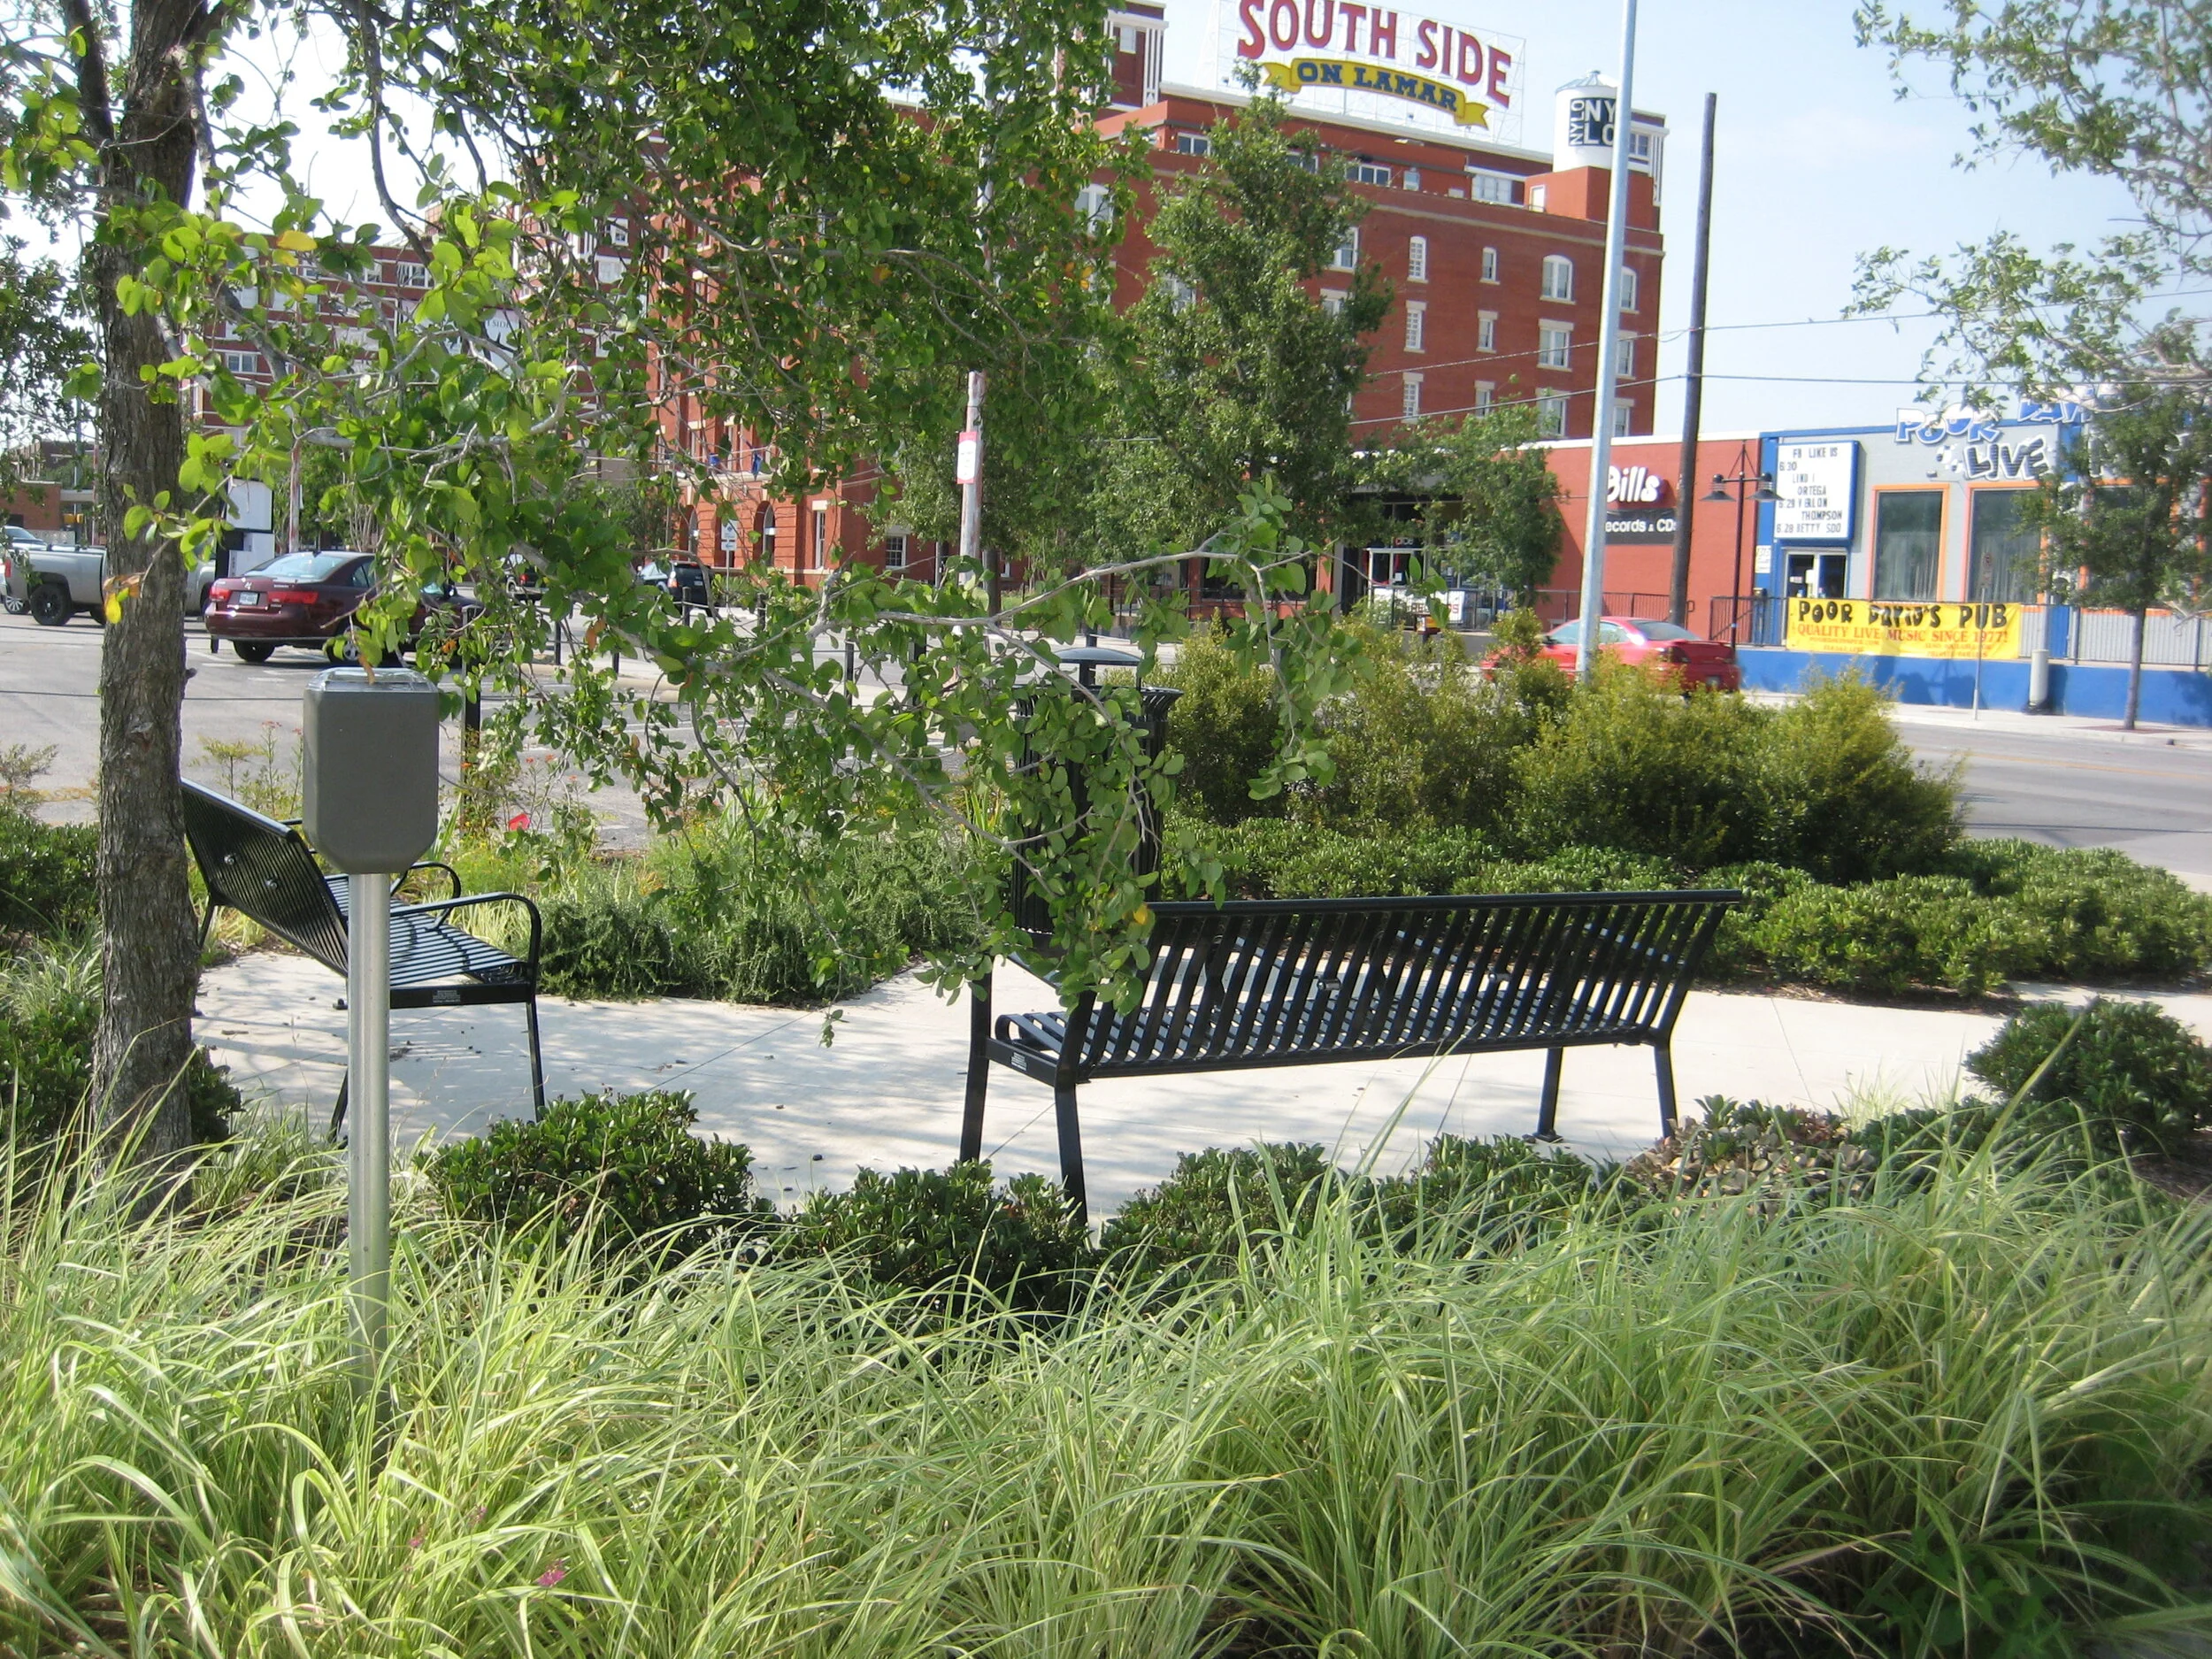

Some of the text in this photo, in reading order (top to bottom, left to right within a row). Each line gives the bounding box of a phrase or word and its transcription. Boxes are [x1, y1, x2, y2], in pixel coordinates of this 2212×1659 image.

[1238, 0, 1511, 108] SOUTH SIDE
[1297, 63, 1457, 111] ON LAMAR
[1570, 99, 1585, 145] NYLO
[1585, 99, 1617, 122] NY
[1895, 403, 2001, 443] POOR
[1809, 447, 1826, 458] LIKE
[1830, 447, 1839, 457] US
[1963, 434, 2053, 480] LIVE
[1797, 485, 1827, 495] ORTEGA
[1605, 518, 1646, 533] ecords
[1801, 510, 1843, 520] THOMPSON
[1798, 600, 1853, 623] POOR
[1959, 603, 2008, 629] PUB
[1798, 623, 1848, 638] QUALITY
[1854, 626, 1881, 640] LIVE
[1887, 629, 1925, 641] MUSIC
[1932, 630, 1968, 642] SINCE
